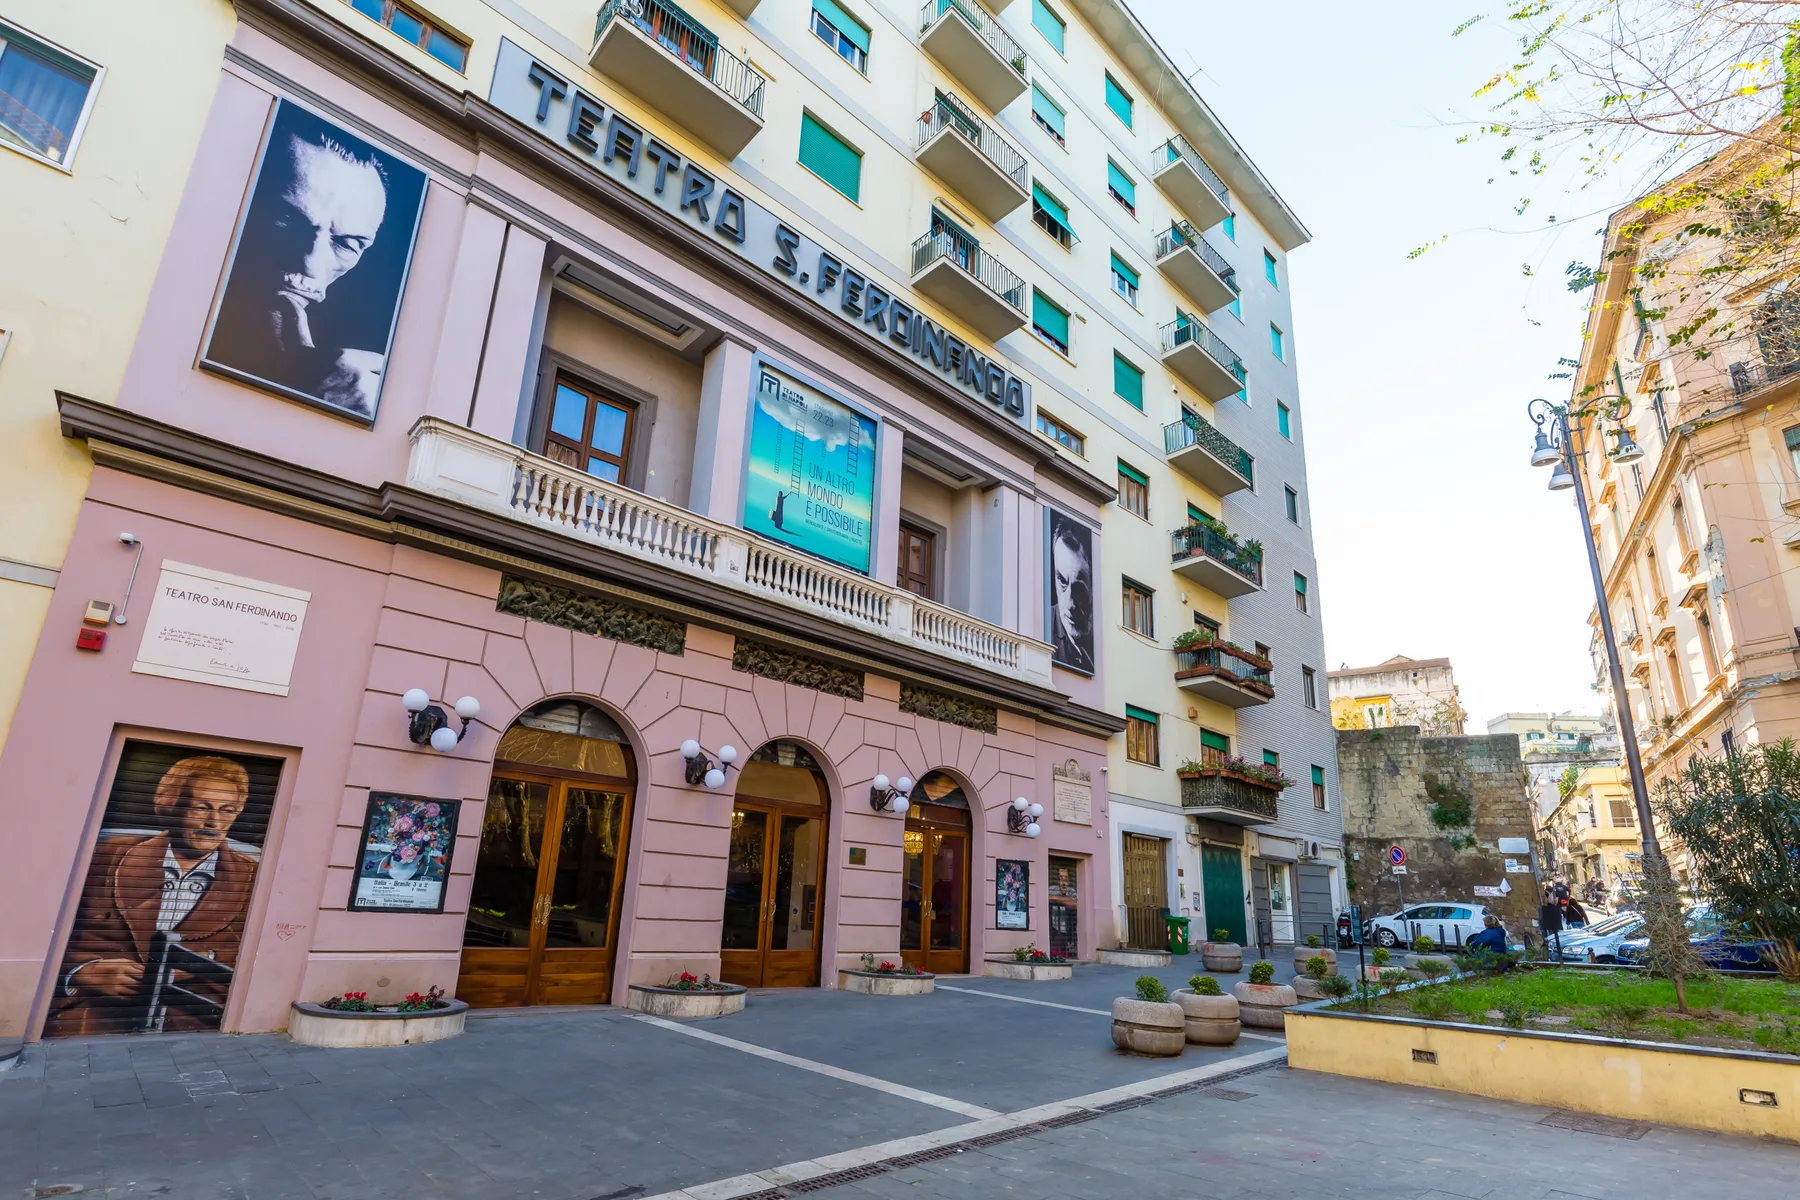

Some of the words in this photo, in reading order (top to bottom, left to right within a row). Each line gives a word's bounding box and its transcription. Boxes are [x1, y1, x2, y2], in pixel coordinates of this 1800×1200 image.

[528, 60, 745, 244] TEATRO
[816, 251, 1025, 418] FERDINANDO
[783, 387, 804, 402] TEATRO
[788, 395, 808, 409] NAPOLI
[807, 481, 844, 510] MONDO
[808, 462, 823, 481] UN
[825, 470, 855, 496] ALTRO
[805, 497, 812, 516] È
[815, 504, 863, 537] POSSIBILE
[165, 587, 209, 604] TEATRO
[211, 597, 233, 610] SAN
[235, 602, 298, 623] FERDINANDO
